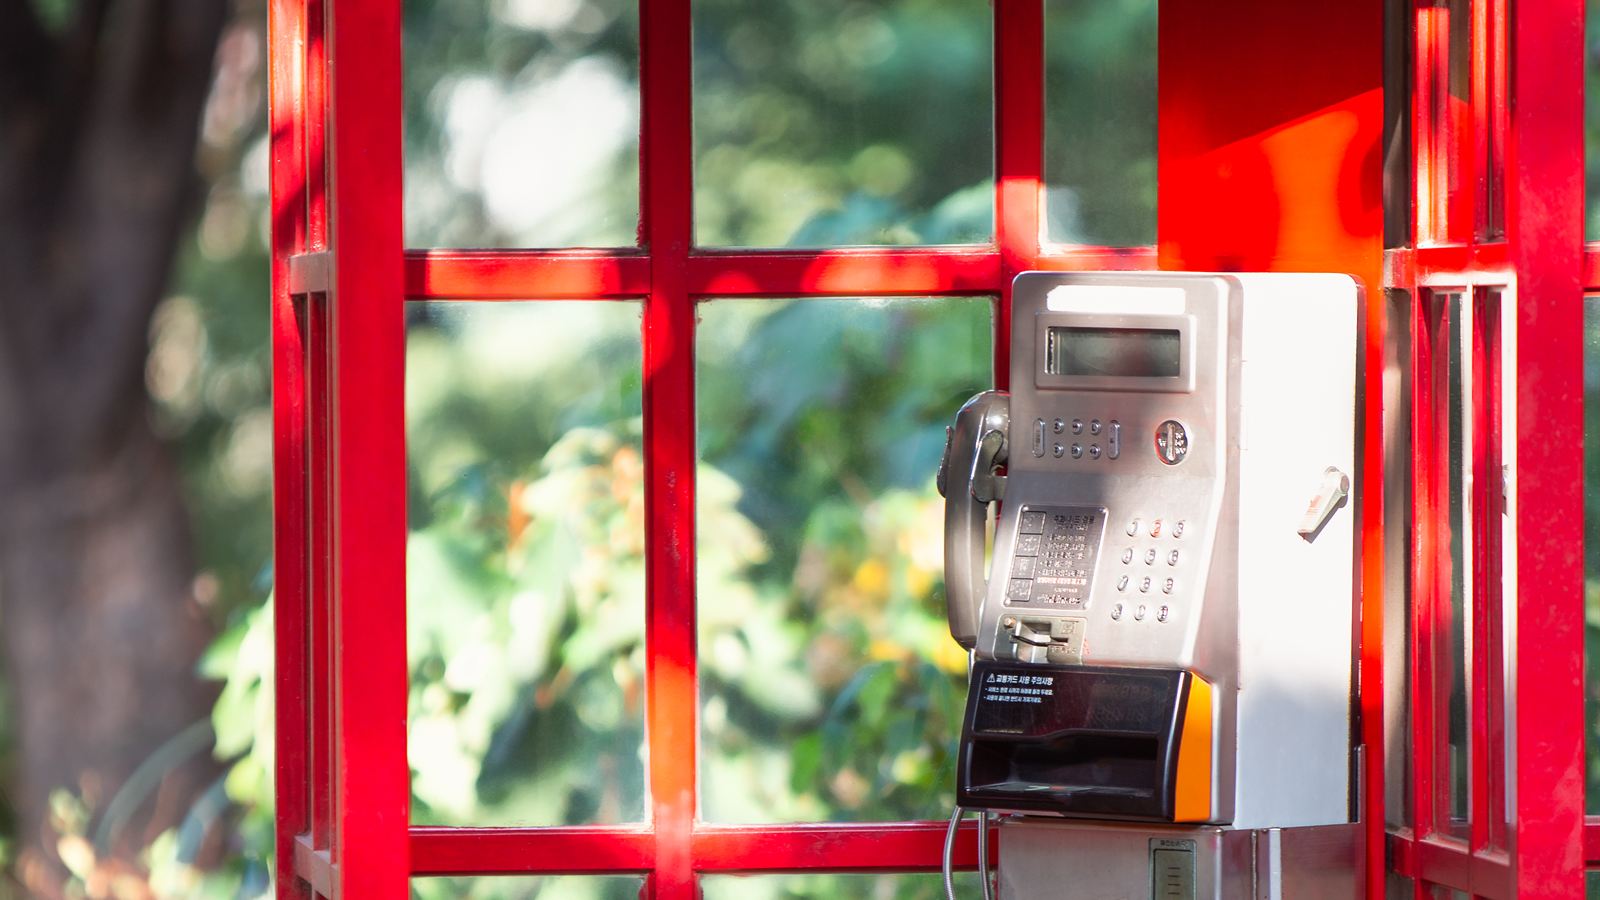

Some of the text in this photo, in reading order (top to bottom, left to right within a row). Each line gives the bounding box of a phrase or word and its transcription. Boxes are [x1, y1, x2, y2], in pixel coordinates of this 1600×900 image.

[996, 674, 1054, 686] 교통카드 사용 주의사항
